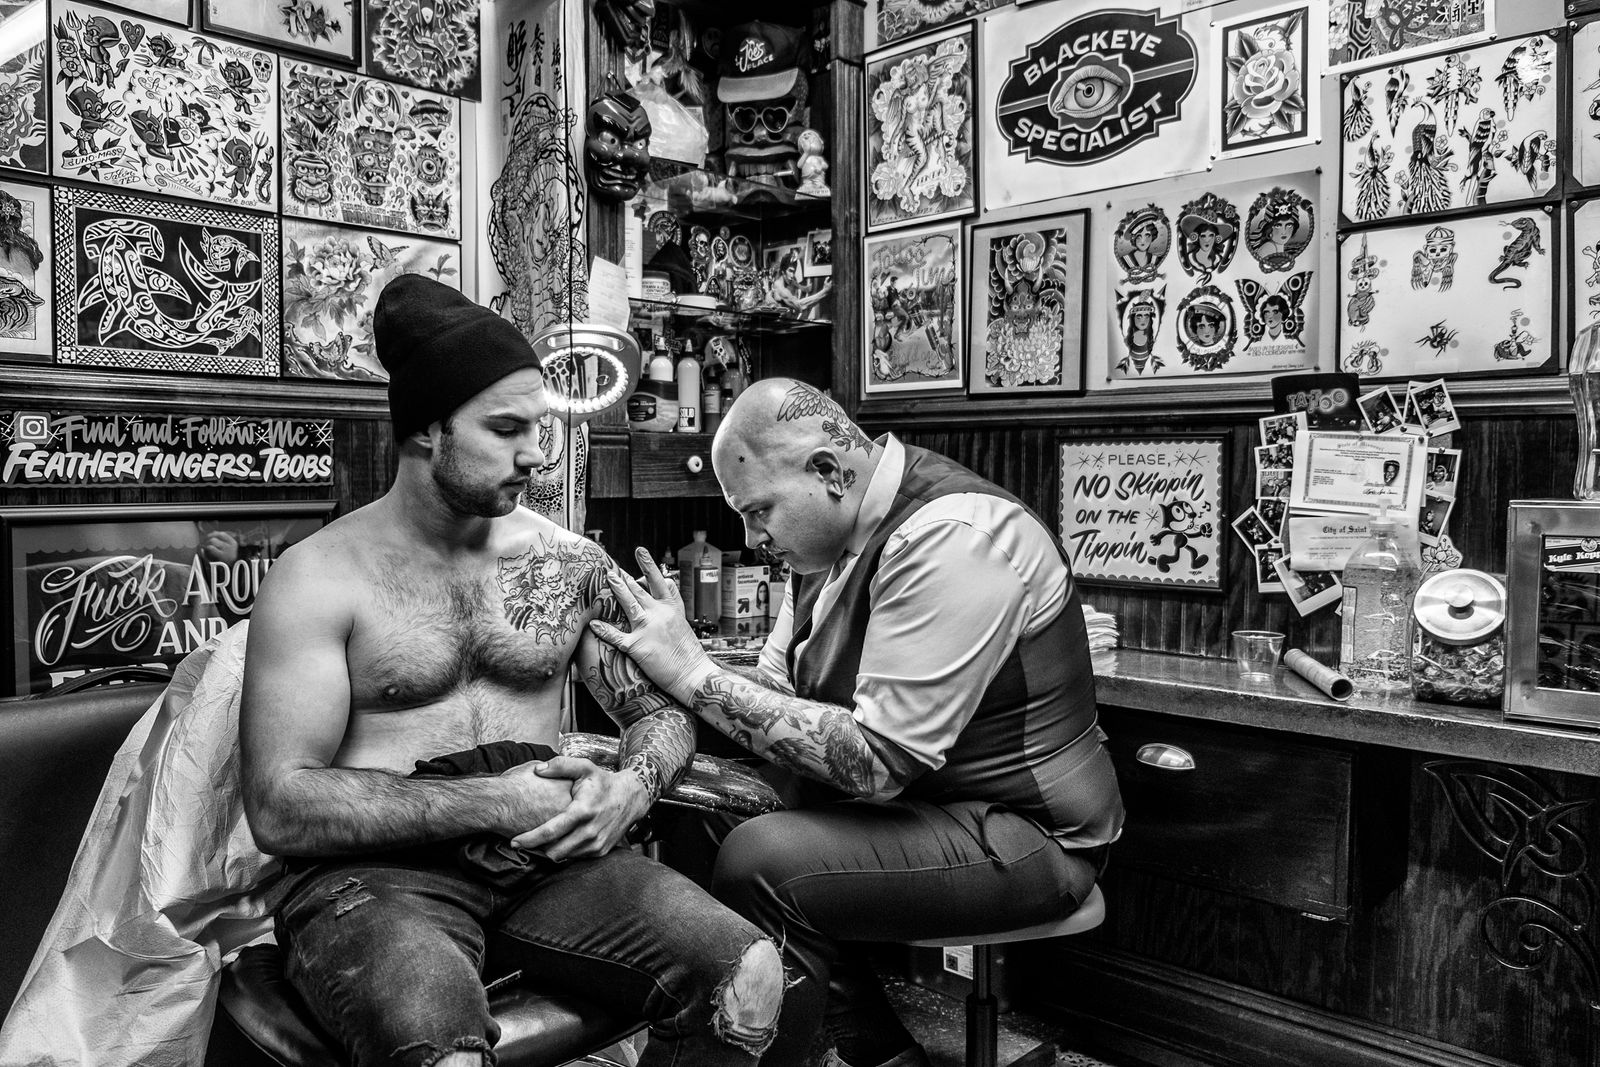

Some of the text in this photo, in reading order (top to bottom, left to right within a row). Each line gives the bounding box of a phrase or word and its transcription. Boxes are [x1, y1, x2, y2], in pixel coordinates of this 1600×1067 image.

[1023, 29, 1162, 86] BLACKEYE
[1014, 92, 1162, 153] SPECIALIST
[50, 414, 308, 452] Find and Follow Me
[1108, 453, 1171, 468] PLEASE,
[1073, 473, 1111, 499] NO
[1075, 509, 1140, 525] ON THE
[1322, 525, 1337, 535] City
[1346, 525, 1368, 535] Saint
[1069, 529, 1148, 568] Tippin
[35, 553, 278, 666] Fuck AROU
